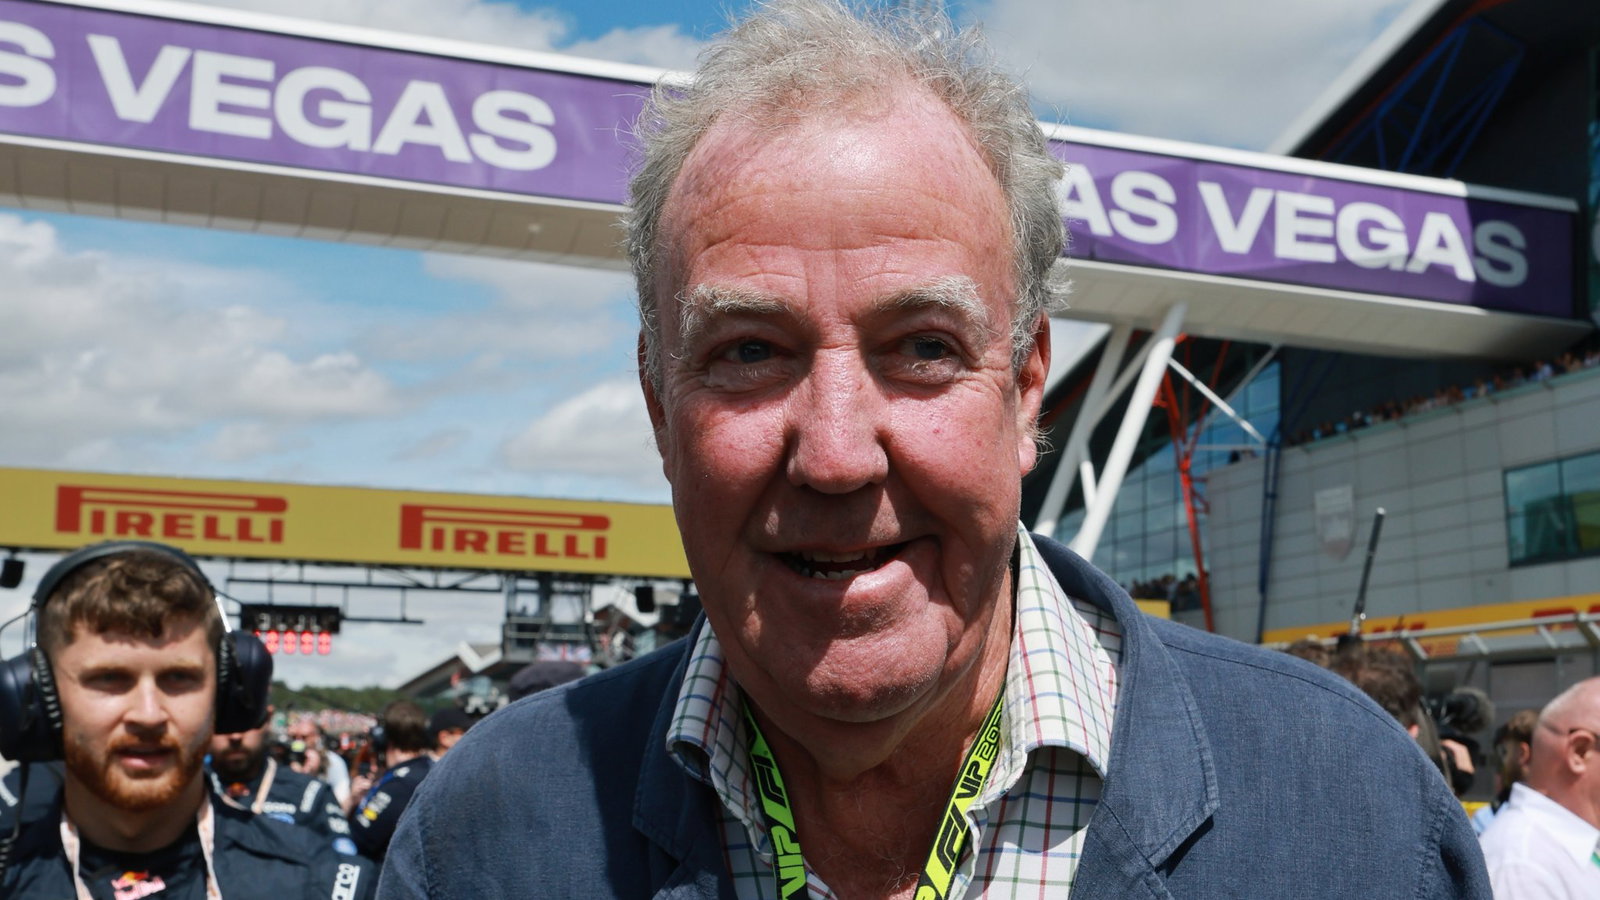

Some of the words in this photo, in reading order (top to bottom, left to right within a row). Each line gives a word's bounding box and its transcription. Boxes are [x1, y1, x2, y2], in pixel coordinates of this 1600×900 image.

[86, 34, 558, 171] VEGAS
[1198, 181, 1528, 287] VEGAS
[55, 485, 288, 543] PIRELLI
[399, 503, 611, 560] PIRELLI
[955, 760, 984, 800] VIP
[771, 825, 807, 900] VIP
